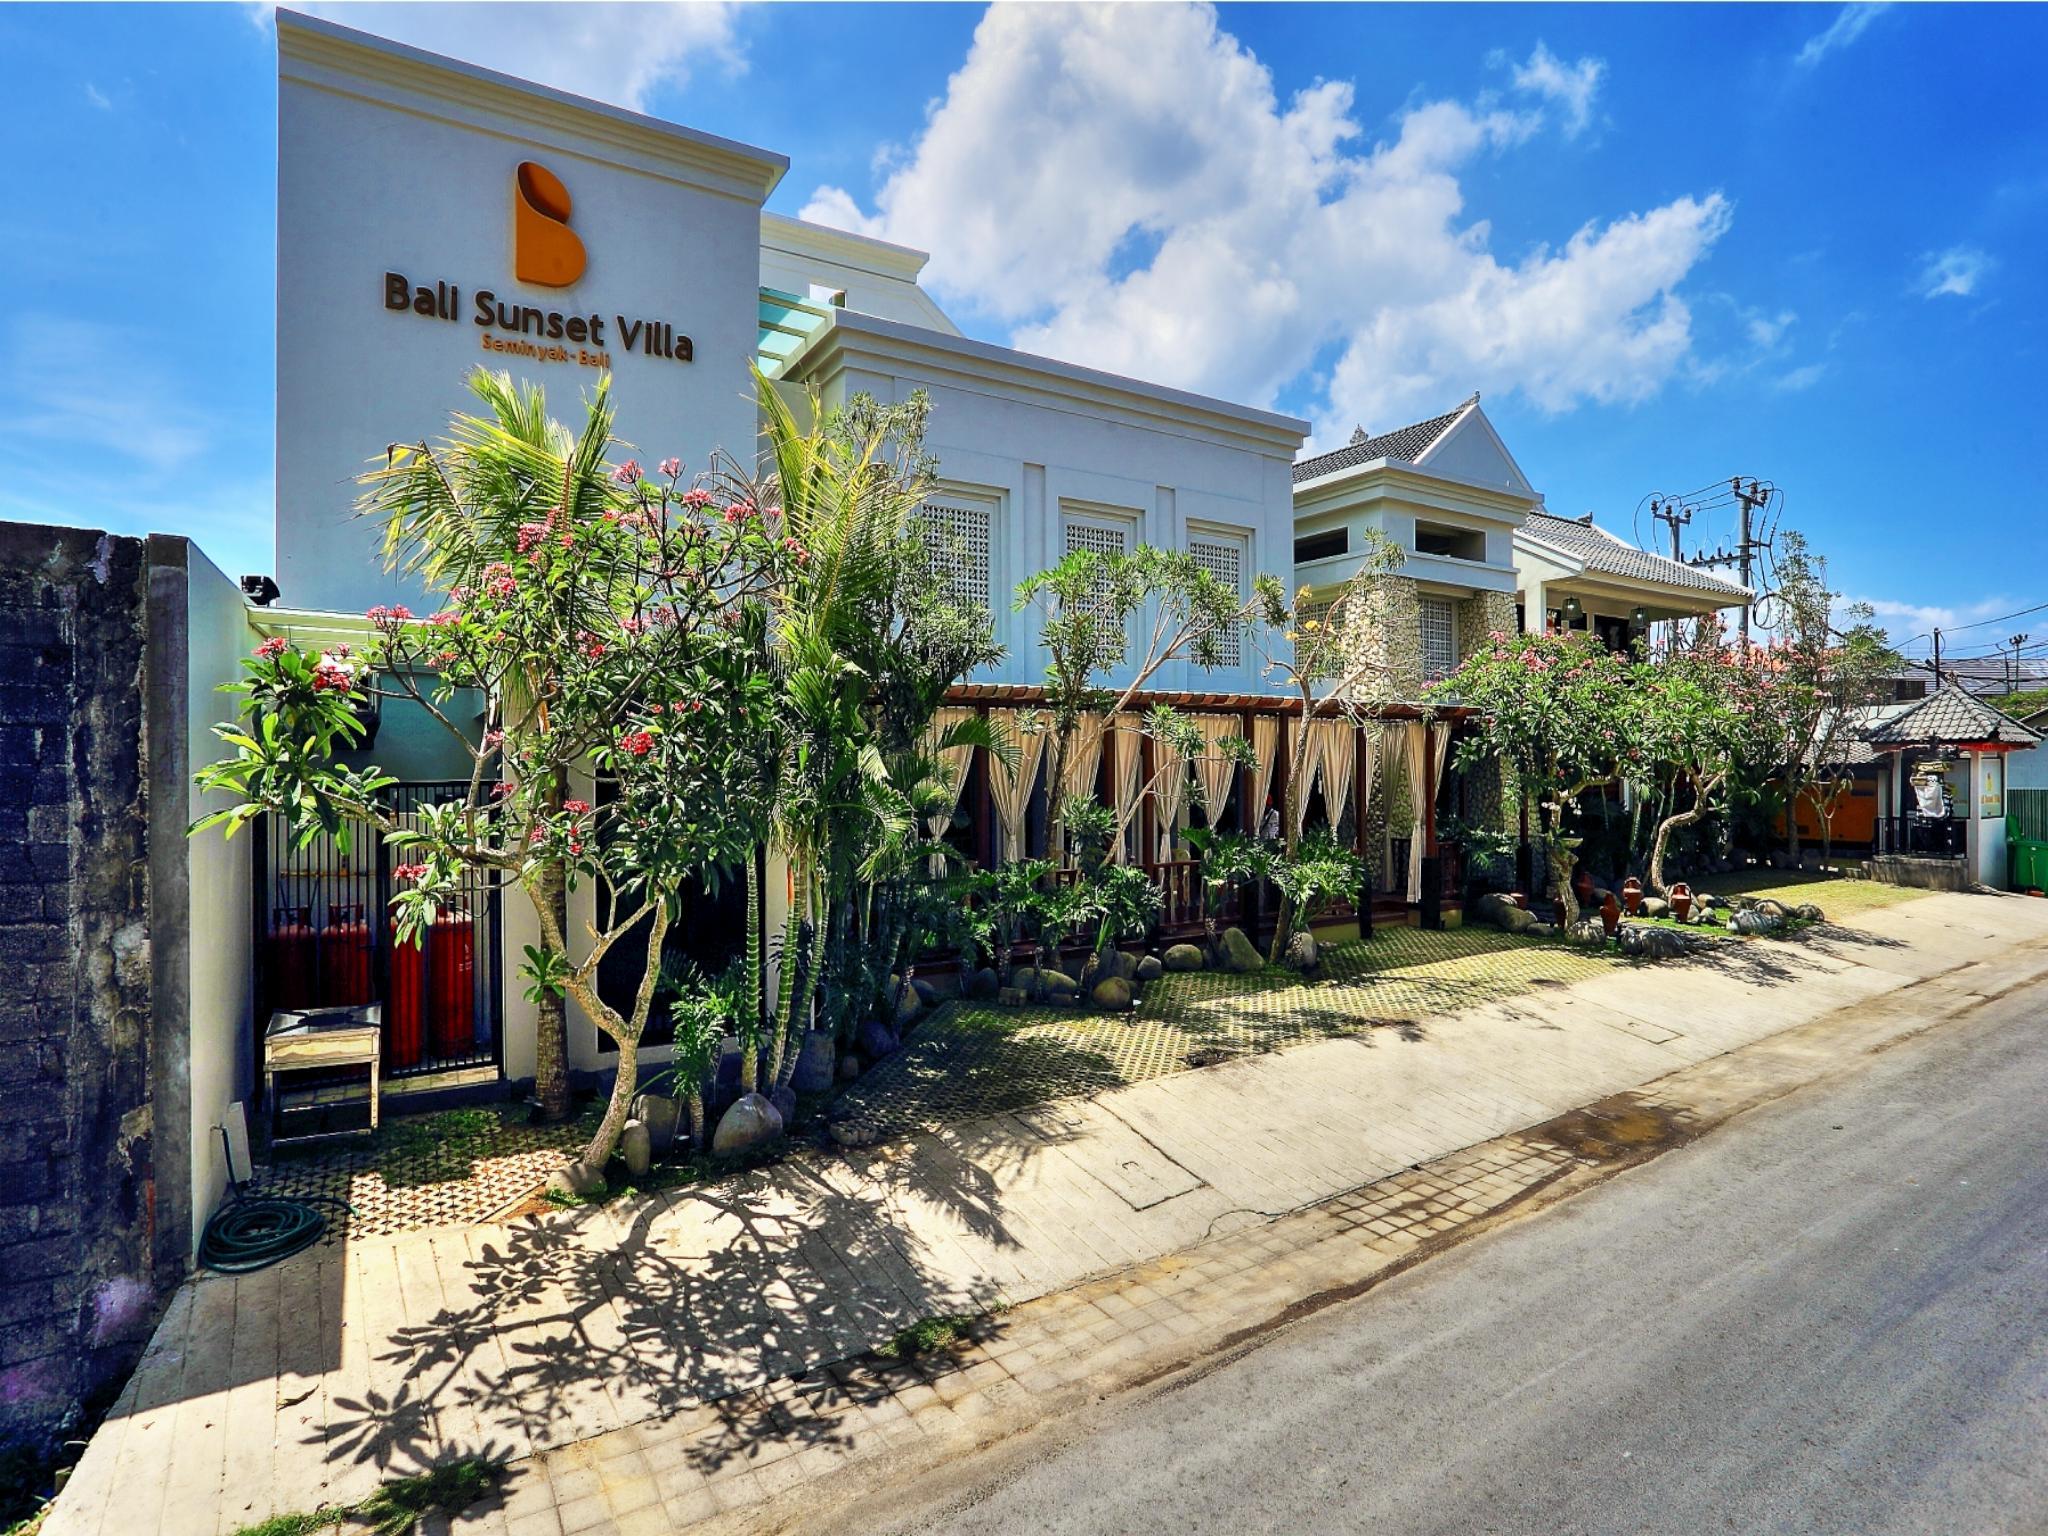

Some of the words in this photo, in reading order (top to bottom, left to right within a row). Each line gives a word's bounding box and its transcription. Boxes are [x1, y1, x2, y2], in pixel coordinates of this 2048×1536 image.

[384, 271, 458, 321] Bali
[474, 289, 605, 347] Sunset
[616, 314, 694, 362] Villa
